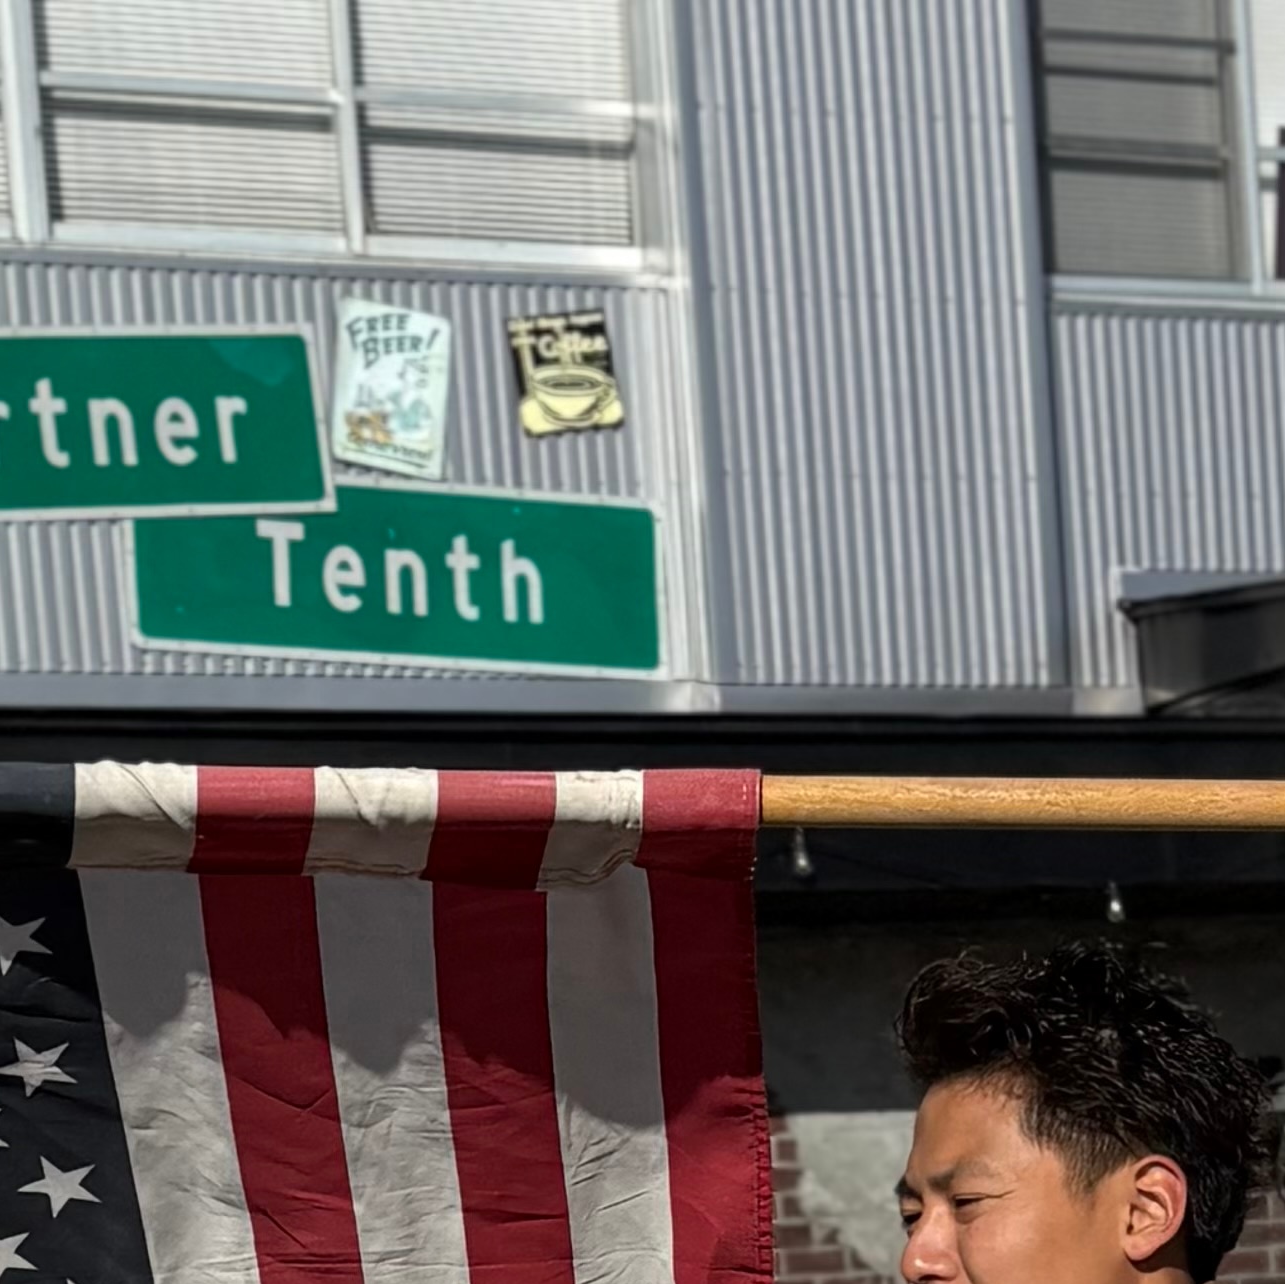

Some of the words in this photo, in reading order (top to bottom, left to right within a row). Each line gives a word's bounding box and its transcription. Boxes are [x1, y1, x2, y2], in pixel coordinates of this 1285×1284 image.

[346, 313, 410, 350] FREE
[362, 326, 440, 370] BEER!
[256, 519, 545, 625] Tenth
